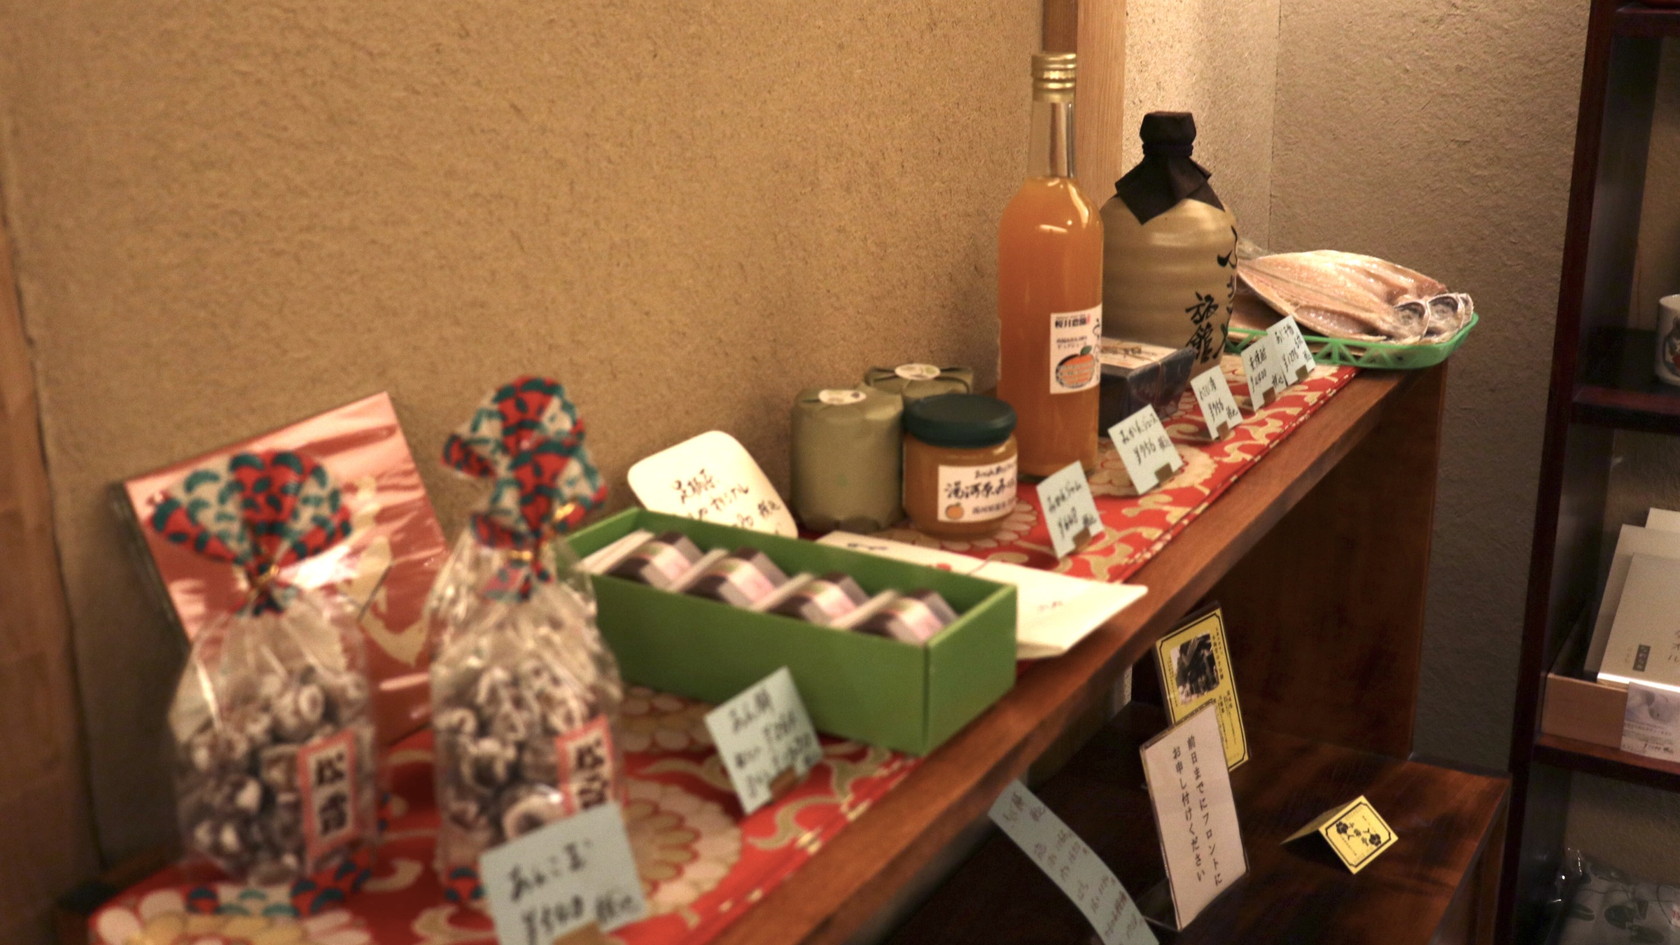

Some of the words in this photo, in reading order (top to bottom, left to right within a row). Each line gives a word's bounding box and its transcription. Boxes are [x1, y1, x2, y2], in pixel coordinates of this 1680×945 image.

[1172, 745, 1206, 884] お申し付けください
[1186, 735, 1223, 887] 前日までにフロントに
